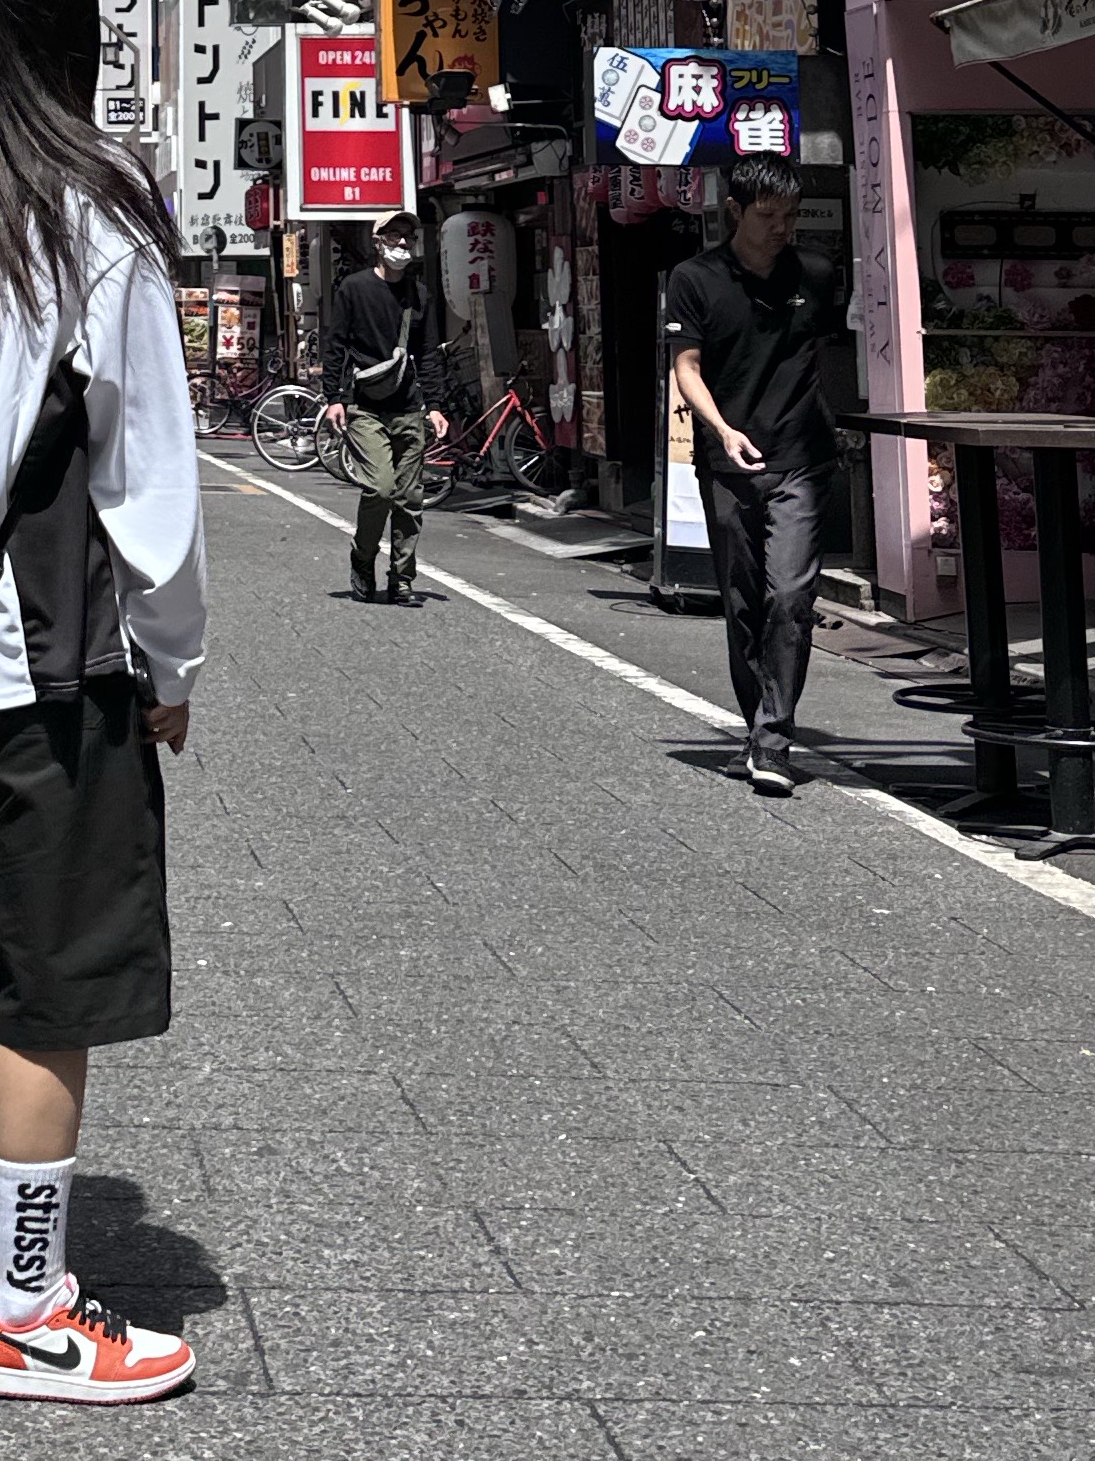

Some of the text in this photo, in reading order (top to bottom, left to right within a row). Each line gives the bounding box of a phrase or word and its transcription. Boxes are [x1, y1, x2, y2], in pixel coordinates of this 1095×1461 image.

[318, 50, 352, 65] OPEN
[730, 69, 791, 90] フリー
[311, 90, 389, 119] FINE
[310, 167, 393, 182] ONLINE CAFE
[343, 186, 361, 201] B1
